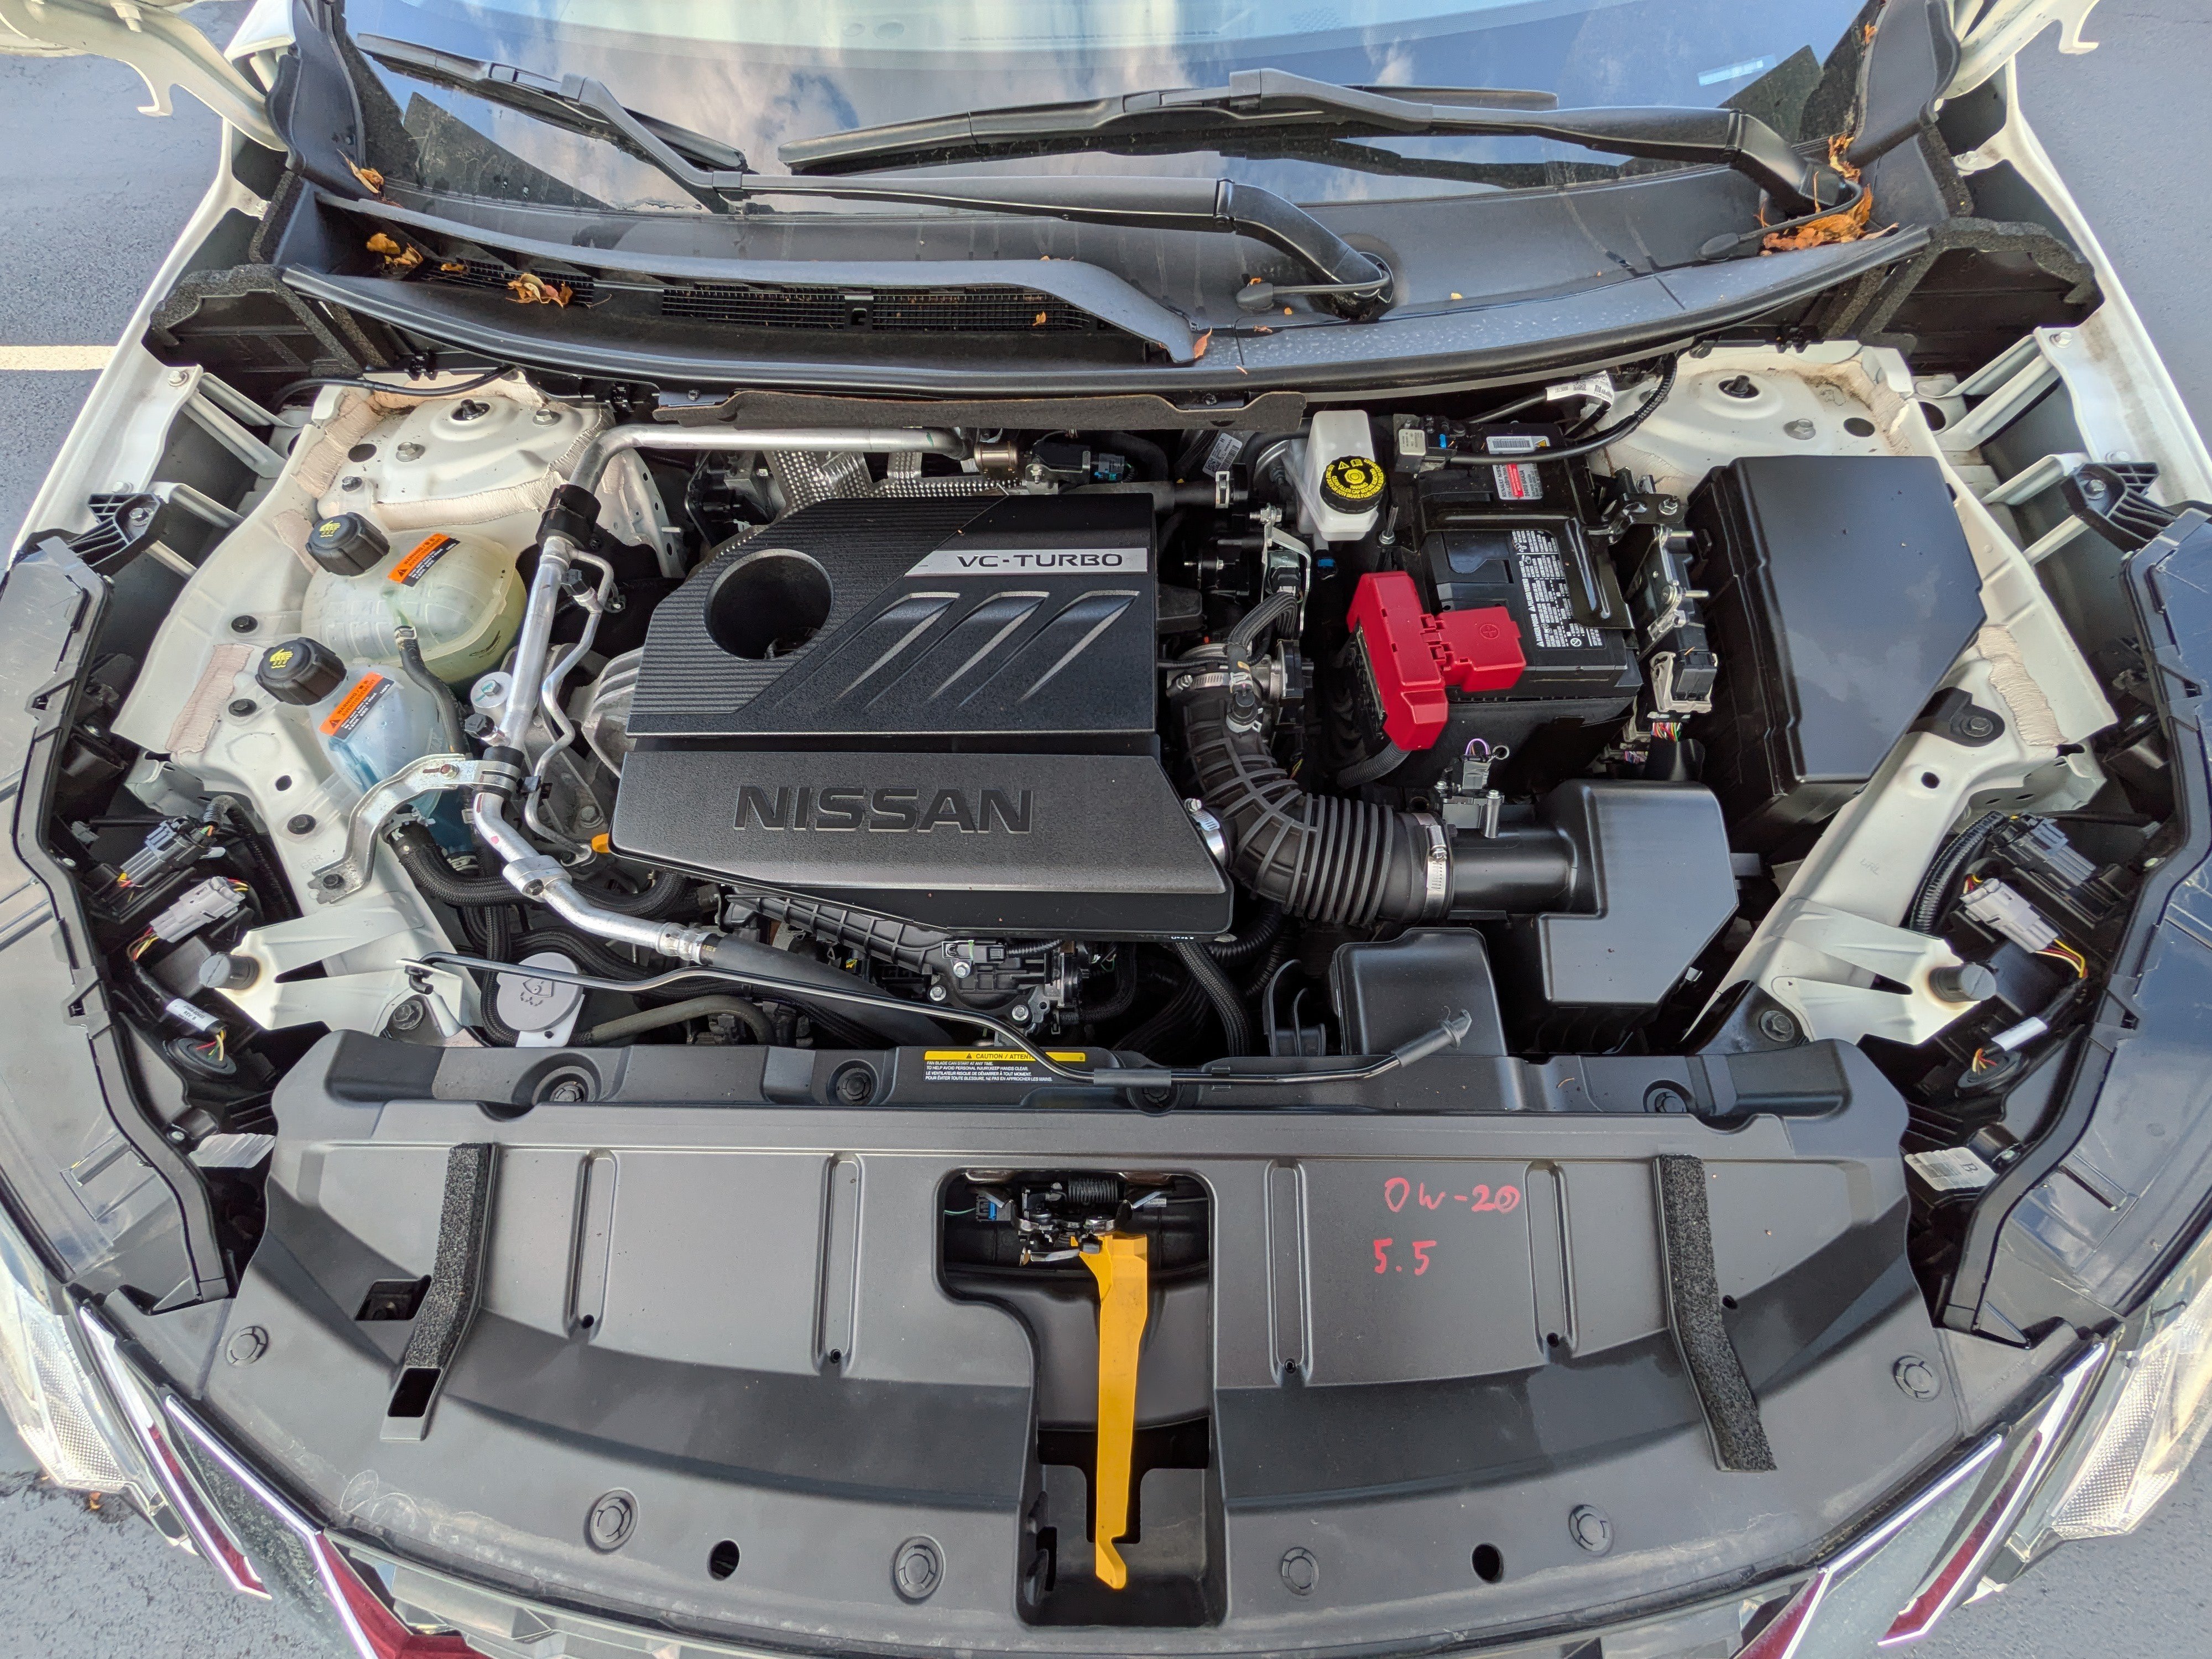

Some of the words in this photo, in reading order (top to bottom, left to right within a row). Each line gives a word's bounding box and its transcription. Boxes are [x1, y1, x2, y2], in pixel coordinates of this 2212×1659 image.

[1360, 483, 1375, 493] BEFORE
[1498, 478, 1506, 497] RENAULT
[404, 547, 422, 564] WARNING
[408, 538, 442, 567] AVERTISSEMENT
[957, 554, 1123, 567] VC-TURBO
[337, 693, 356, 713] WARNING
[342, 679, 375, 716] AVERTISSEMENT
[733, 785, 1033, 833] NISSAN
[1960, 1162, 1978, 1173] B
[1374, 1238, 1437, 1275] 5.5
